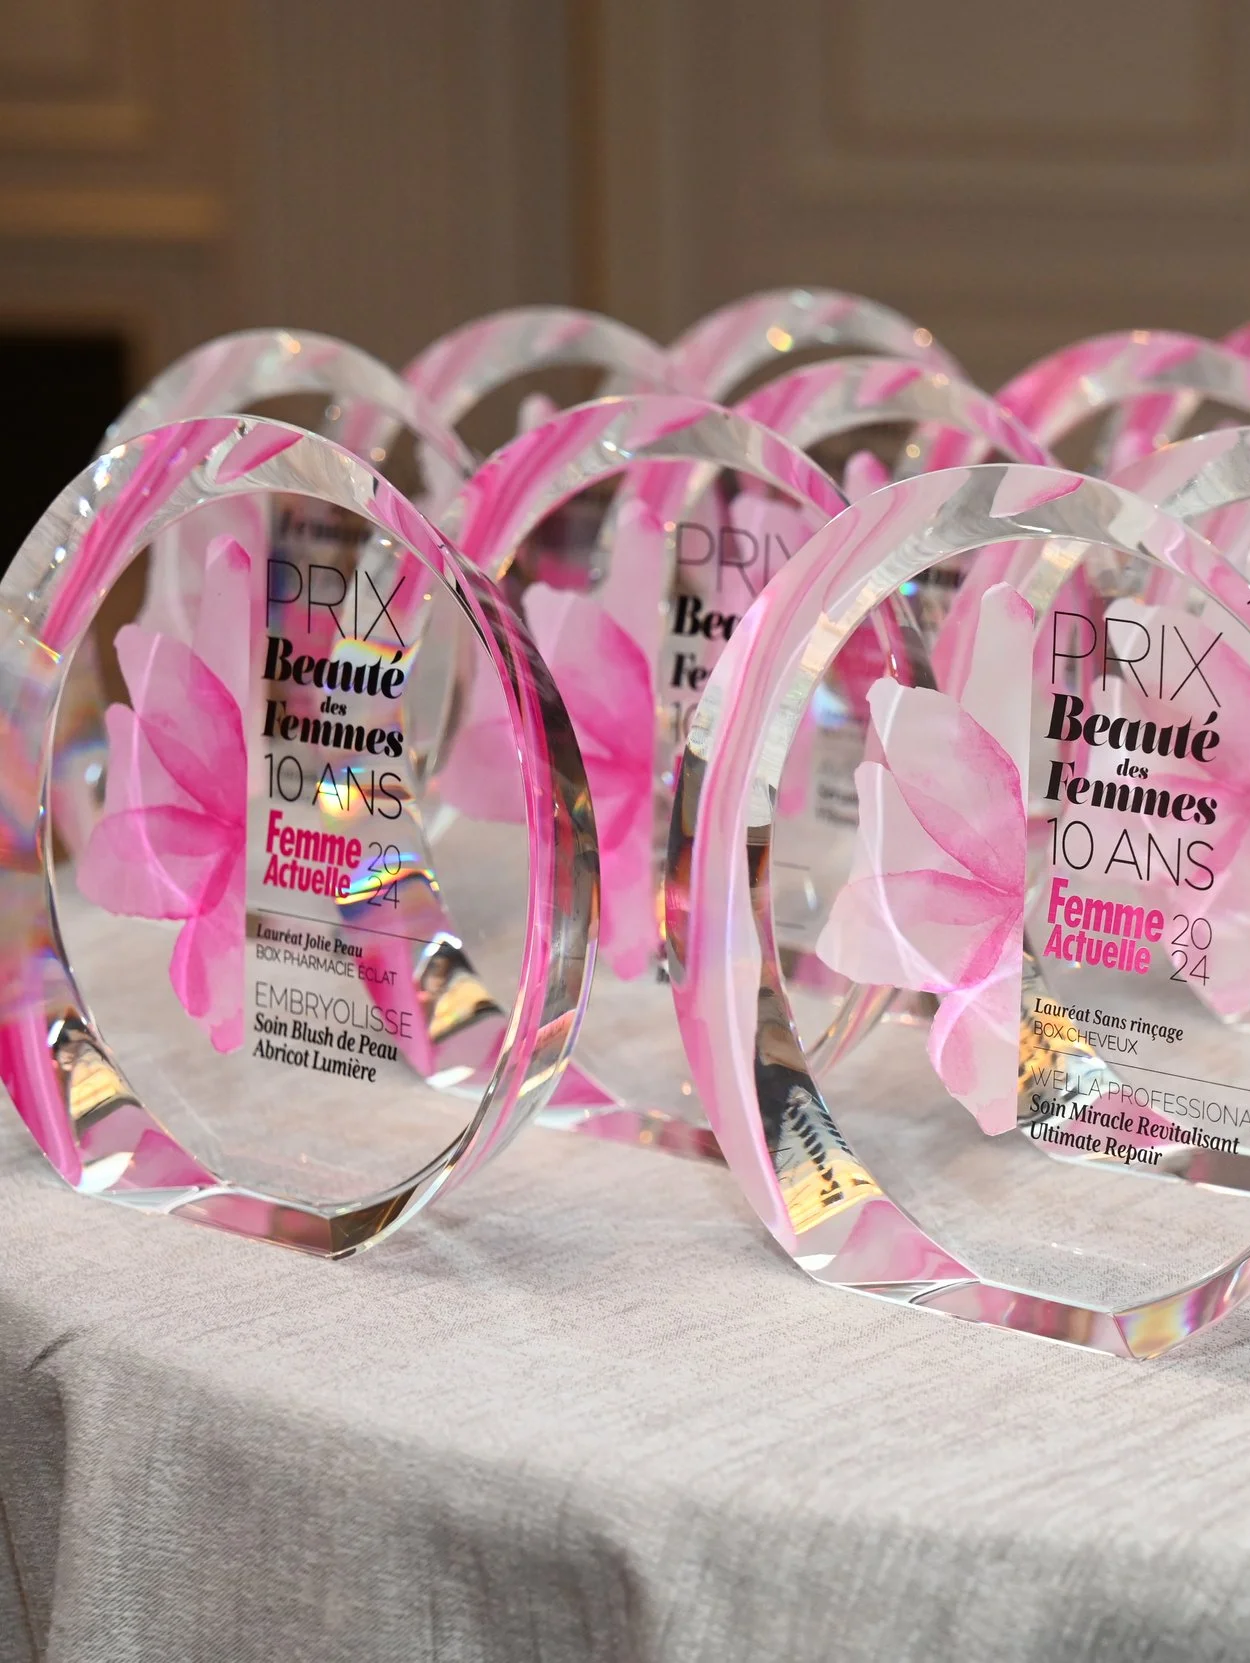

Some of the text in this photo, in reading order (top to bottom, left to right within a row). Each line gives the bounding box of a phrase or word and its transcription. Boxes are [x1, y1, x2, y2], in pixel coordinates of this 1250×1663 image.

[266, 559, 406, 647] PRIX
[261, 636, 405, 699] Beauté
[1051, 611, 1223, 708] PRIX
[261, 699, 404, 757] Femmes
[320, 696, 347, 716] des
[1044, 693, 1220, 762] Beauté
[264, 753, 402, 819] 10 ANS
[1044, 760, 1218, 825] Femmes
[1116, 758, 1148, 779] des
[266, 809, 402, 875] Femme 20
[1047, 817, 1215, 891] 10 ANS
[263, 854, 400, 909] Actuelle 24
[257, 924, 363, 958] Lauréat Jolie Peau
[1048, 877, 1212, 950] Femme 20
[256, 945, 397, 985] BOX PHARMACIE ÉCLAT
[1043, 926, 1210, 986] Actuelle 24
[254, 1013, 398, 1061] Soin Blush de Peau
[255, 981, 413, 1039] EMBRYOLISSE
[1033, 1021, 1138, 1055] BOX CHEVEUX
[1034, 997, 1184, 1042] Lauréat Sans rinçage
[253, 1040, 376, 1083] Abricot Lumière
[1031, 1065, 1101, 1097] WELLA
[1030, 1093, 1240, 1154] Soin Miracle Revitalisant
[1030, 1121, 1163, 1166] Ultimate Repair
